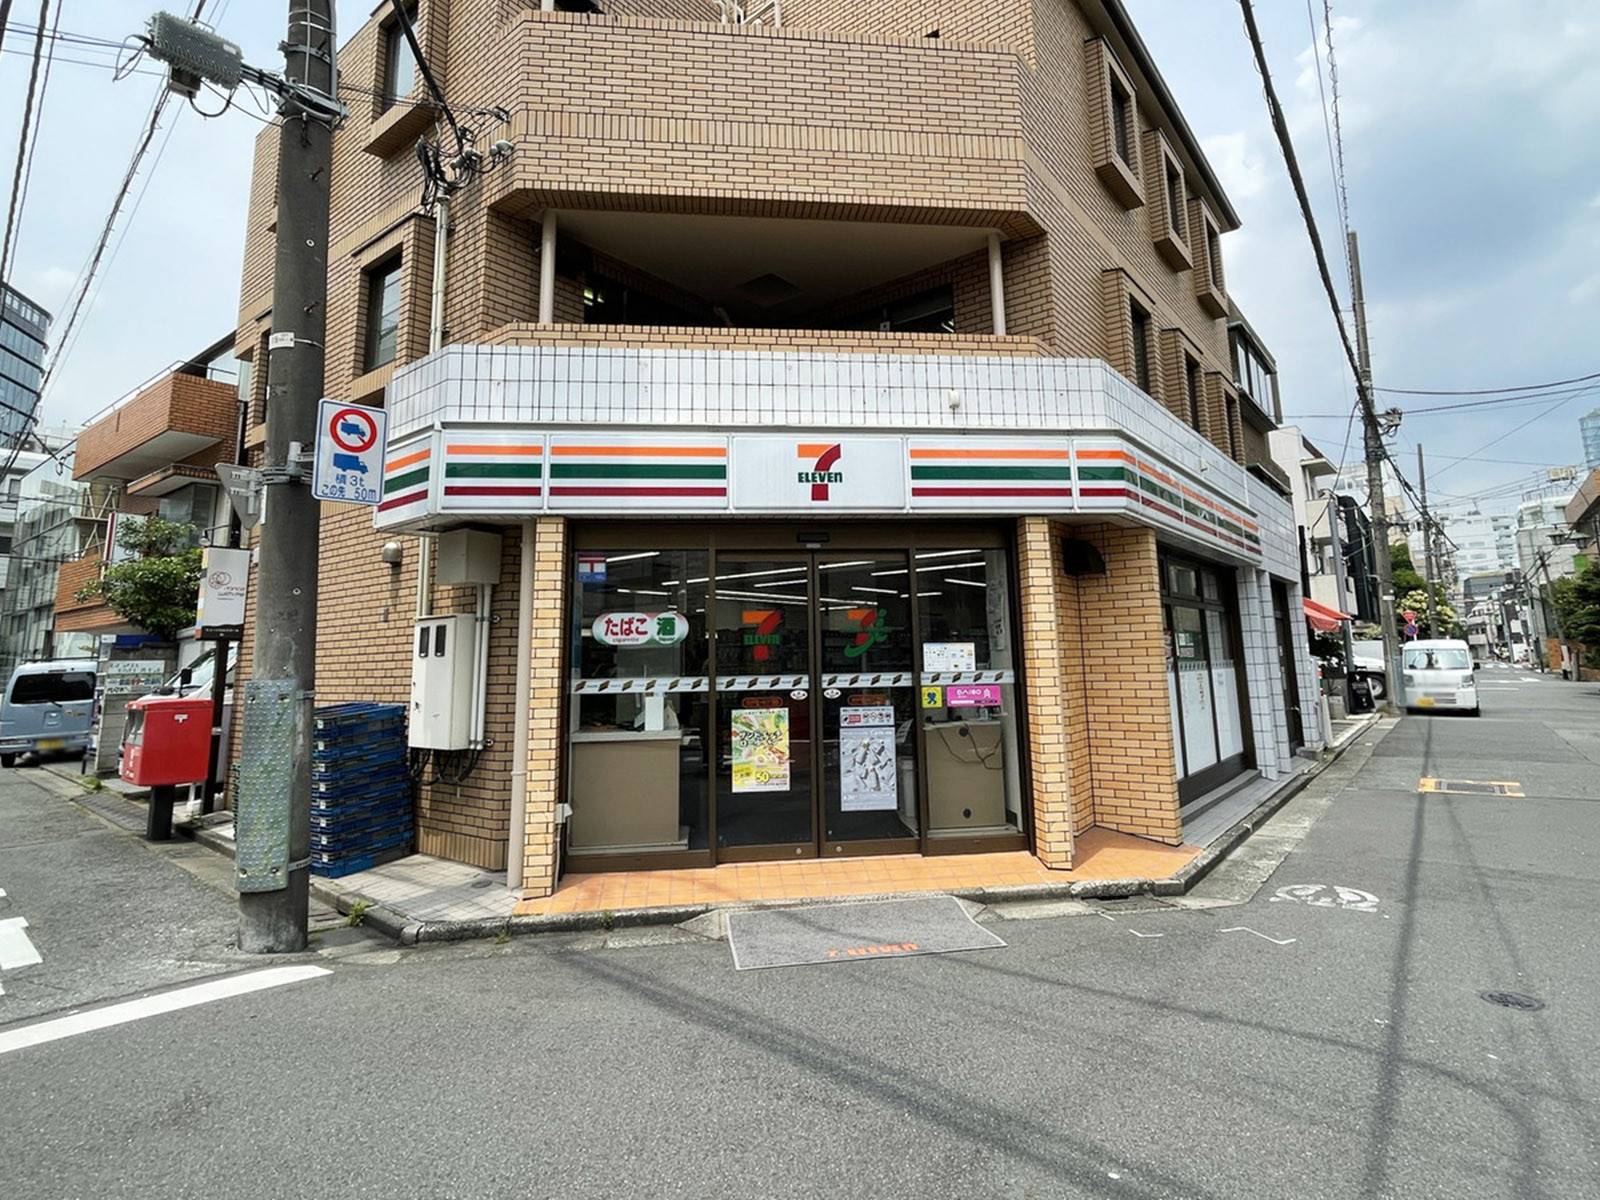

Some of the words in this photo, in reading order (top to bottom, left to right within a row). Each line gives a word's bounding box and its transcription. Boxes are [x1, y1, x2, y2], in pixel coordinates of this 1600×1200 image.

[321, 484, 346, 498] この先
[354, 487, 377, 500] 50m
[604, 617, 648, 636] たばこ
[656, 617, 676, 636] 酒
